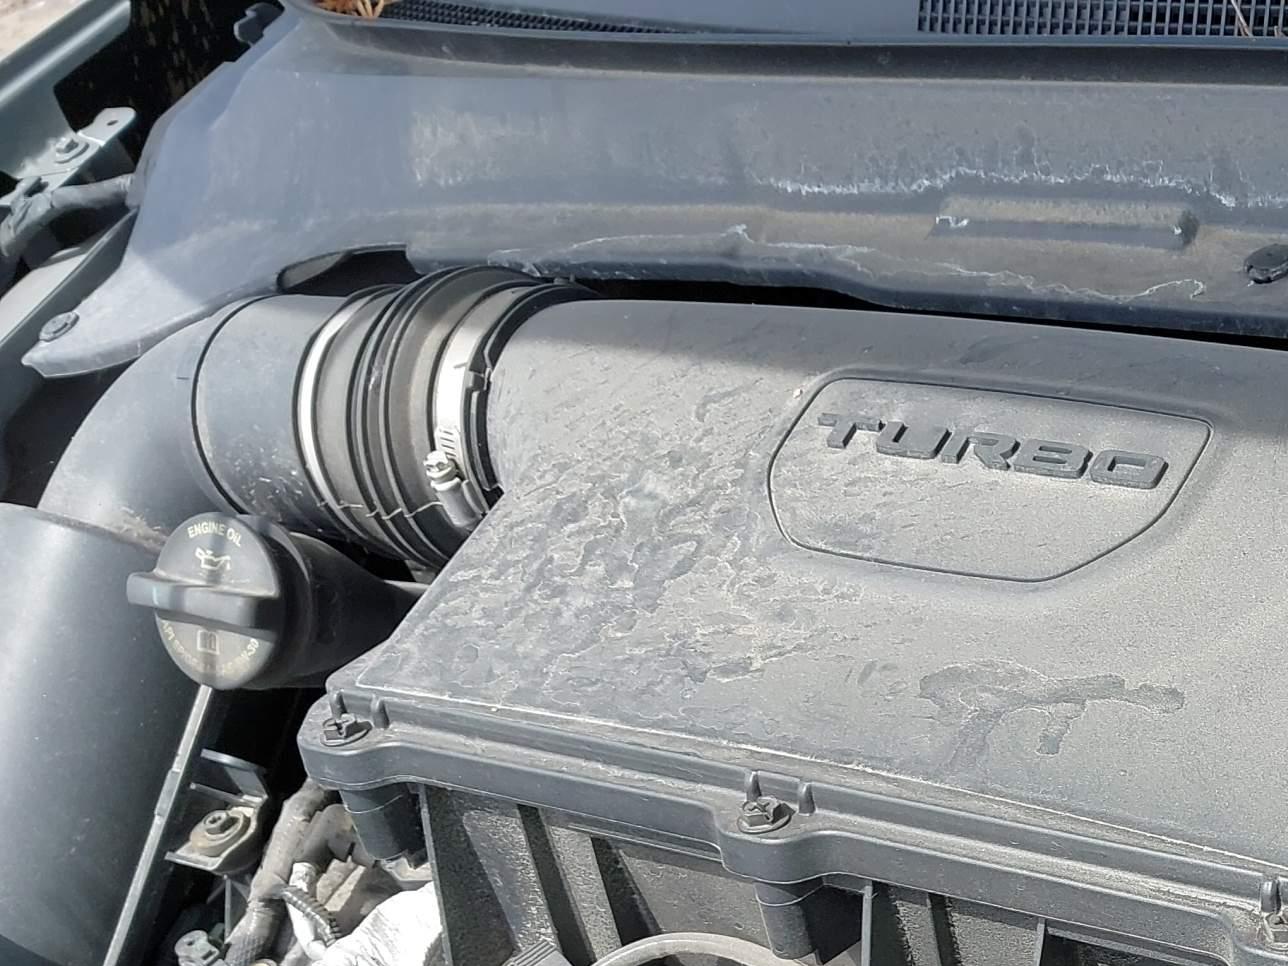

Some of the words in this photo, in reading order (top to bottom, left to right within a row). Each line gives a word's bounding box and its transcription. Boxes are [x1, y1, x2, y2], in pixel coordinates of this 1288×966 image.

[817, 412, 1169, 490] TURBO
[187, 521, 225, 539] ENGINE
[227, 527, 242, 548] OIL
